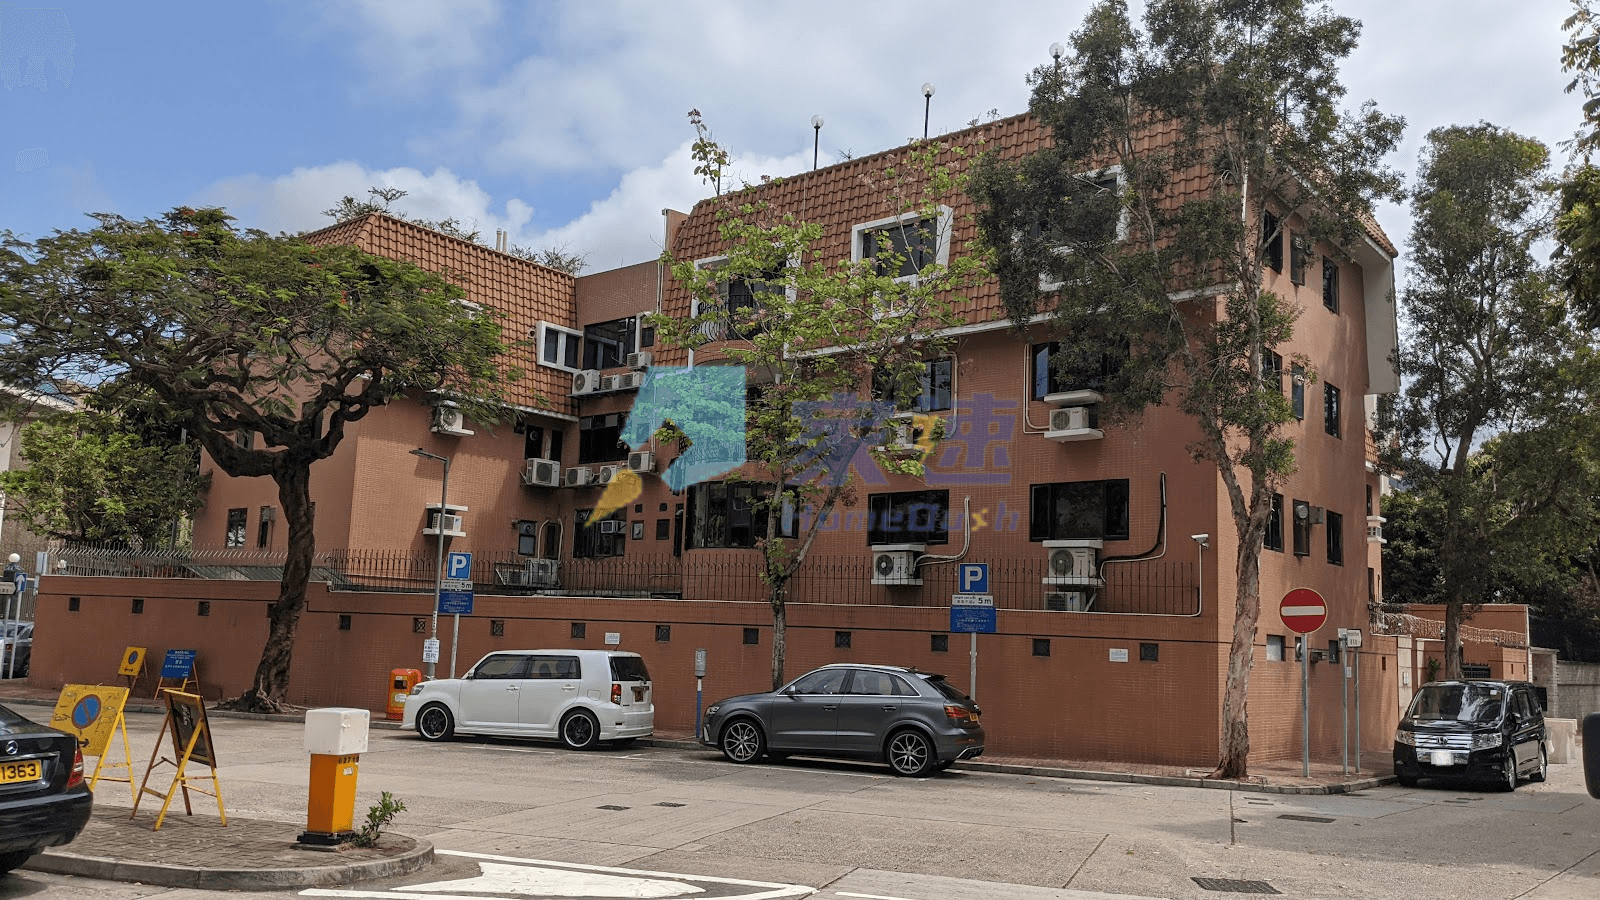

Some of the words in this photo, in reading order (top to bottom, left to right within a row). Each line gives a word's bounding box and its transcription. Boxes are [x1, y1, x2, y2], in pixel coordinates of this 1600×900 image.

[451, 554, 467, 576] P
[964, 566, 983, 590] P
[1, 763, 37, 780] 1363
